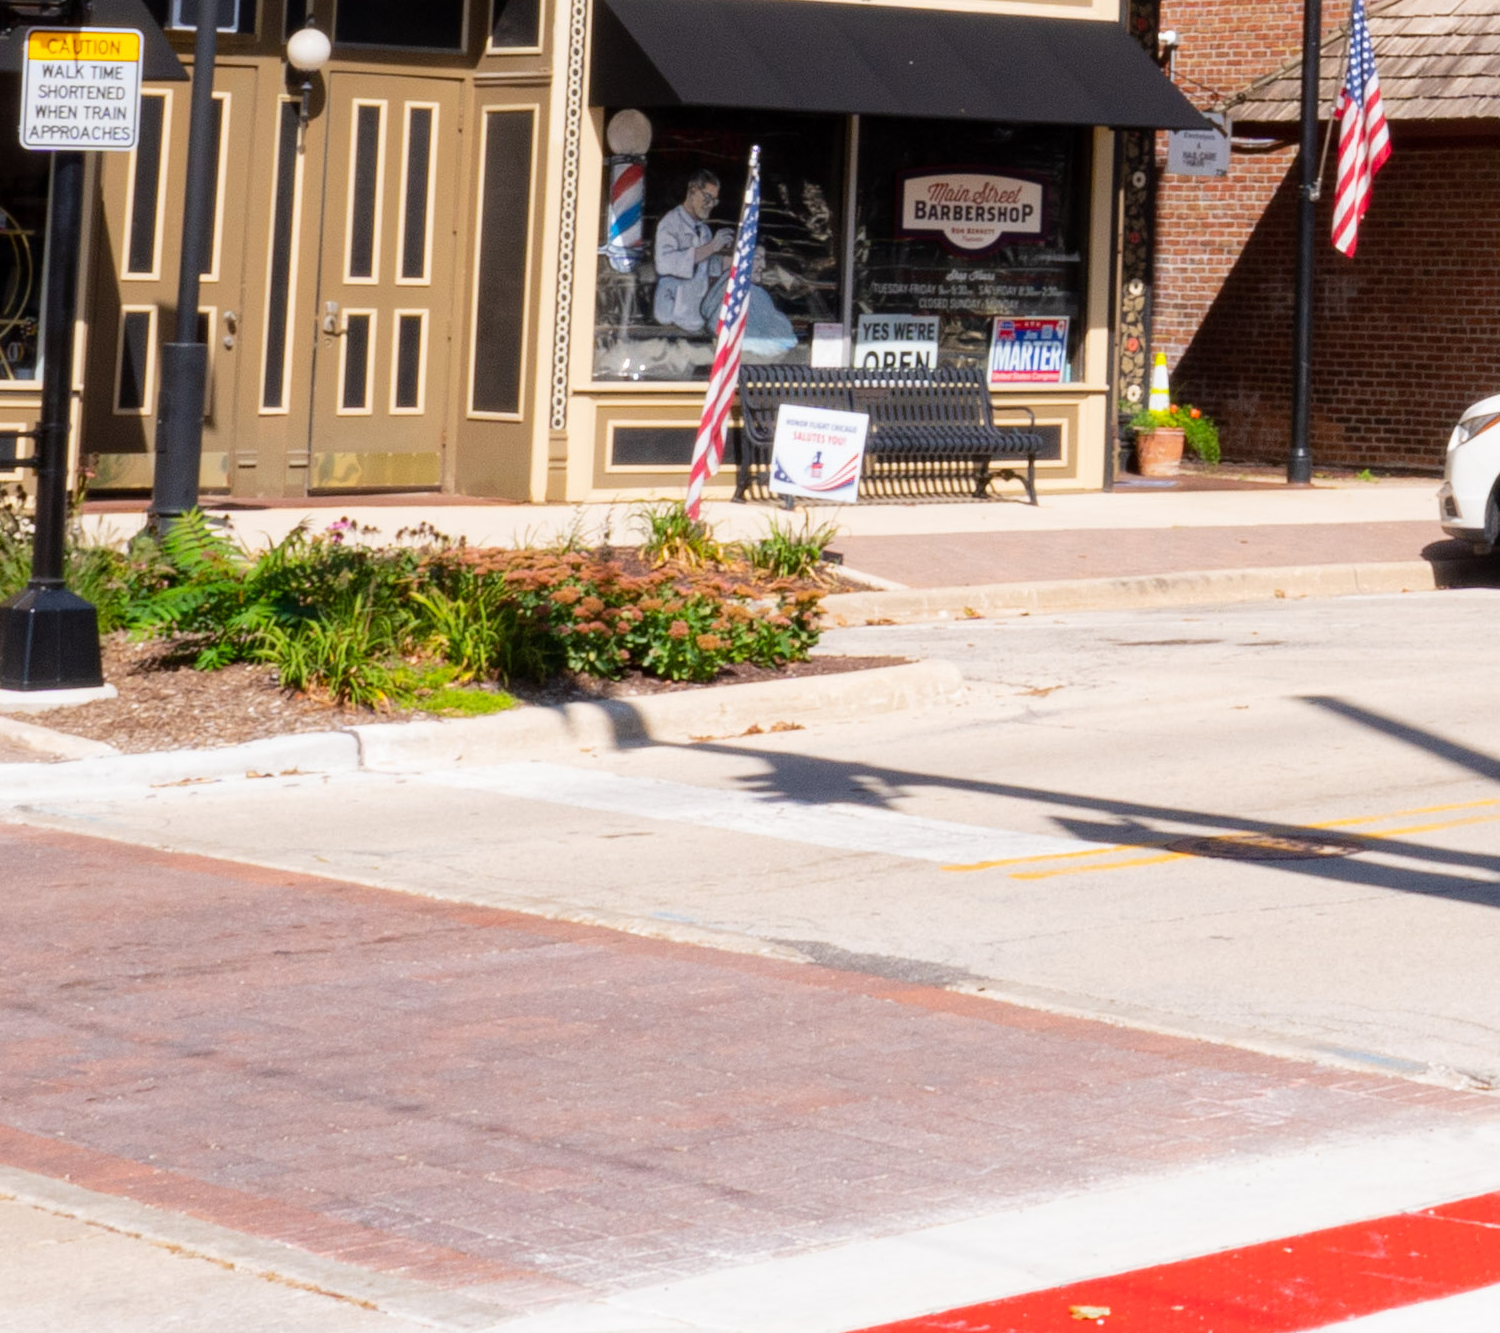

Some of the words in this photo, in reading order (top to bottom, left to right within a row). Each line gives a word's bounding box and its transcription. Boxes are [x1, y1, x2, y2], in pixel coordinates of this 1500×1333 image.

[47, 38, 121, 55] CAUTION
[42, 64, 84, 79] WALK
[91, 65, 123, 80] TIME
[38, 85, 125, 100] SHORTENED
[35, 105, 77, 119] WHEN
[84, 106, 127, 120] TRAIN
[29, 125, 130, 141] APPROACHES
[927, 183, 969, 206] Main
[972, 182, 1022, 204] Street
[914, 201, 1033, 223] BARBERSHOP
[919, 298, 948, 309] CLOSED
[862, 323, 889, 340] YES
[894, 322, 935, 340] WE'RE
[863, 350, 931, 369] OPEN
[994, 341, 1061, 371] MARTER
[793, 431, 825, 443] SALUTES
